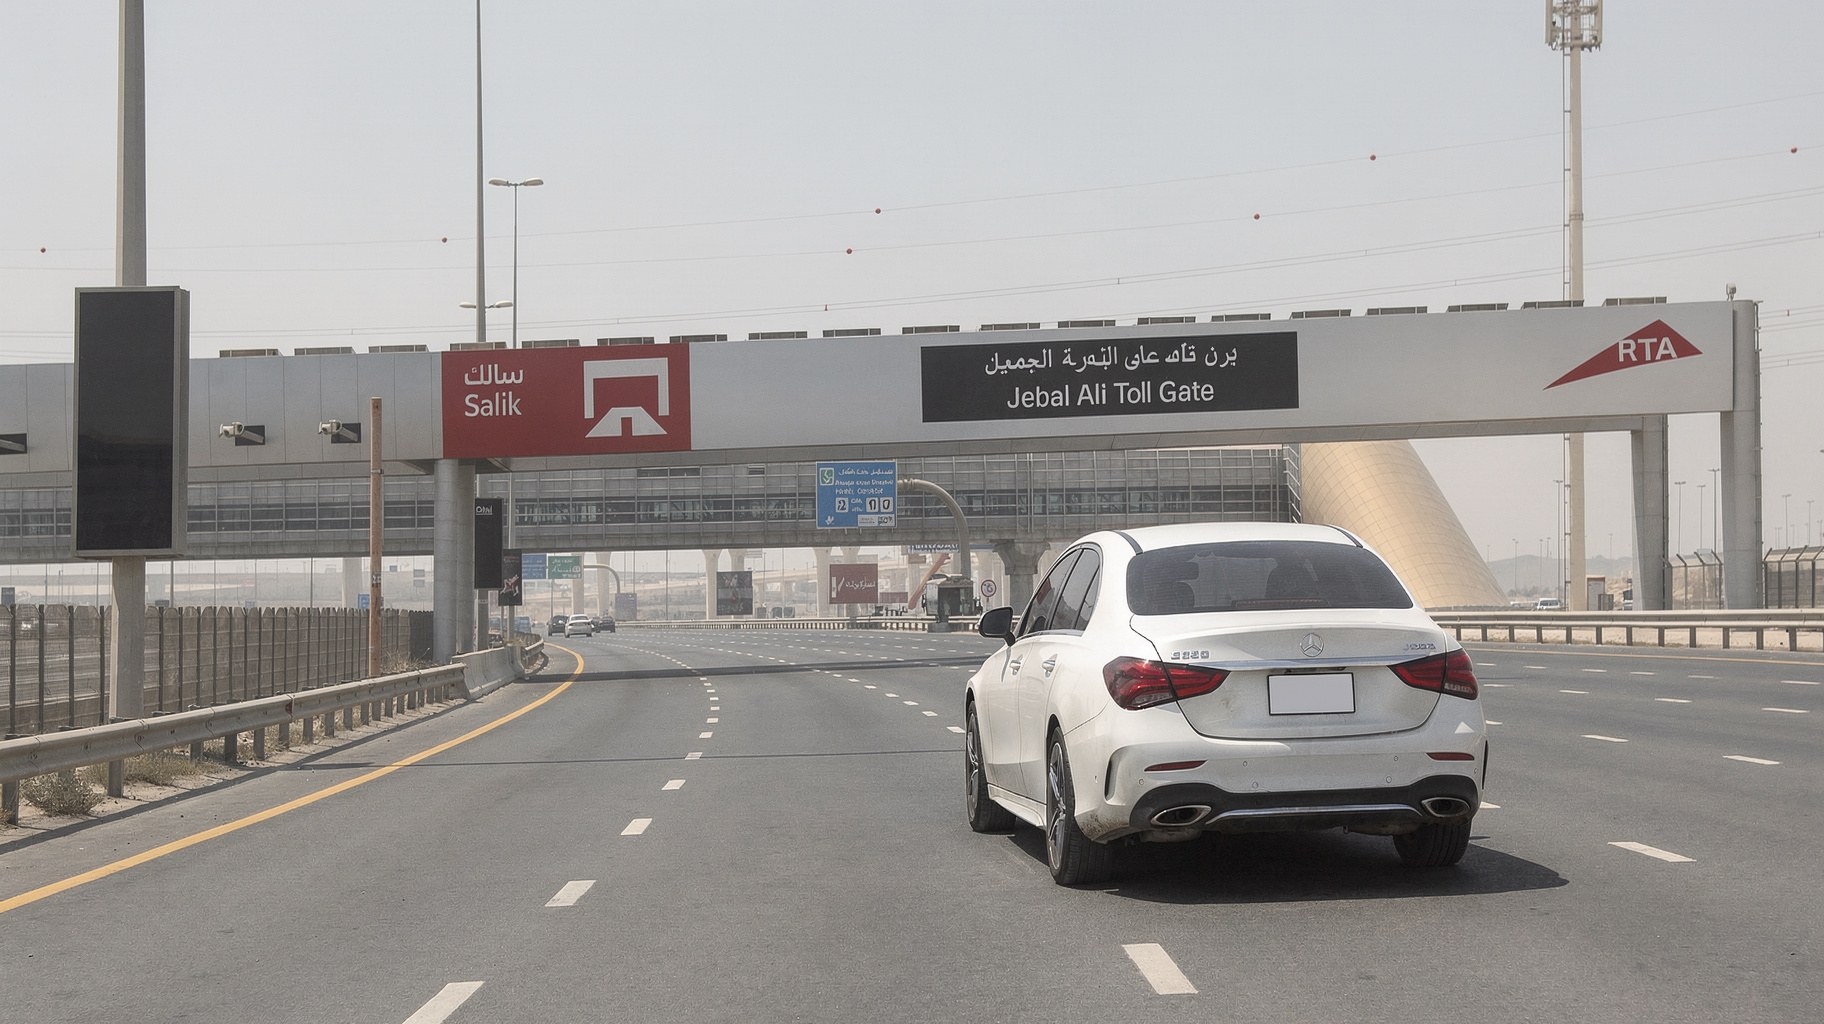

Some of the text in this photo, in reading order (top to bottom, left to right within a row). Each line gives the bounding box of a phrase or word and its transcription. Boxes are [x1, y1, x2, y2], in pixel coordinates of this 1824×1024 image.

[1618, 336, 1677, 362] RTA
[463, 363, 525, 386] سالك
[464, 391, 523, 417] Salik
[1006, 379, 1215, 410] Jebal Ali Toll Gate
